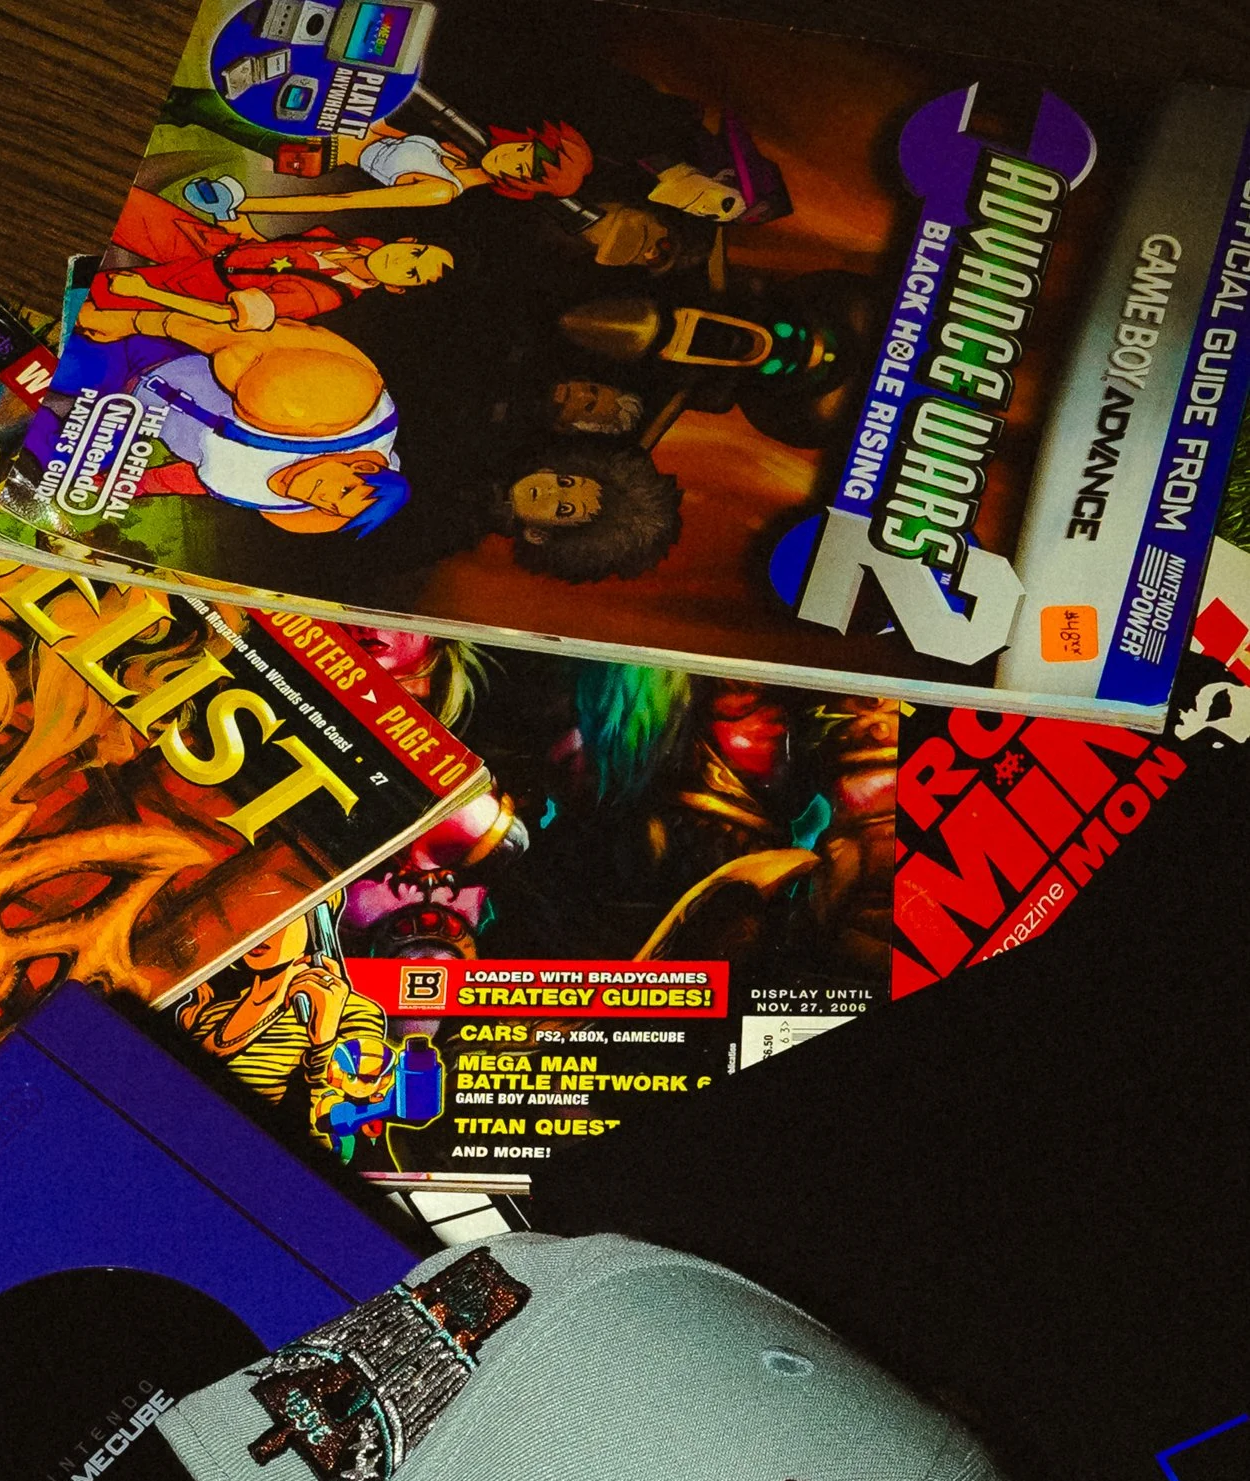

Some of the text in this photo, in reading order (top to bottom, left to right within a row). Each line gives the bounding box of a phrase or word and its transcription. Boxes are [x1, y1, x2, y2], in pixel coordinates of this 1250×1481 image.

[316, 66, 354, 132] ANYWHERE!
[345, 71, 385, 118] PLAY
[337, 118, 370, 140] IT
[928, 153, 1070, 403] ADVANCE
[843, 219, 952, 501] BLACK HOLE RISING
[1066, 231, 1183, 542] GAME BOY ADVANCE
[33, 387, 100, 504] PLAYER'S GUIDE
[69, 402, 133, 503] Nintendo
[1153, 327, 1239, 532] GUIDE FROM
[101, 436, 154, 521] OFFICIAL
[878, 402, 996, 568] WARS
[1118, 582, 1156, 659] POWER
[1150, 553, 1187, 632] NINTENDO
[205, 609, 304, 709] Magazine Wizards
[374, 704, 469, 789] PAGE 10
[457, 987, 713, 1008] STRATEGY GUIDES!
[465, 971, 708, 985] LOADED WITH BRADYGAMES
[750, 987, 874, 1000] DISPLAY UNTIL
[756, 1001, 867, 1014] NOV. 2006
[458, 1055, 598, 1073] MEGA MAN
[460, 1024, 686, 1046] CARS PS2, XBOX, GAMECUBE
[455, 1092, 590, 1106] GAME BOY ADVANCE
[456, 1073, 689, 1093] BATTLE NETWORK
[451, 1145, 552, 1159] AND MORE!
[453, 1117, 622, 1138] TITAN QUEST
